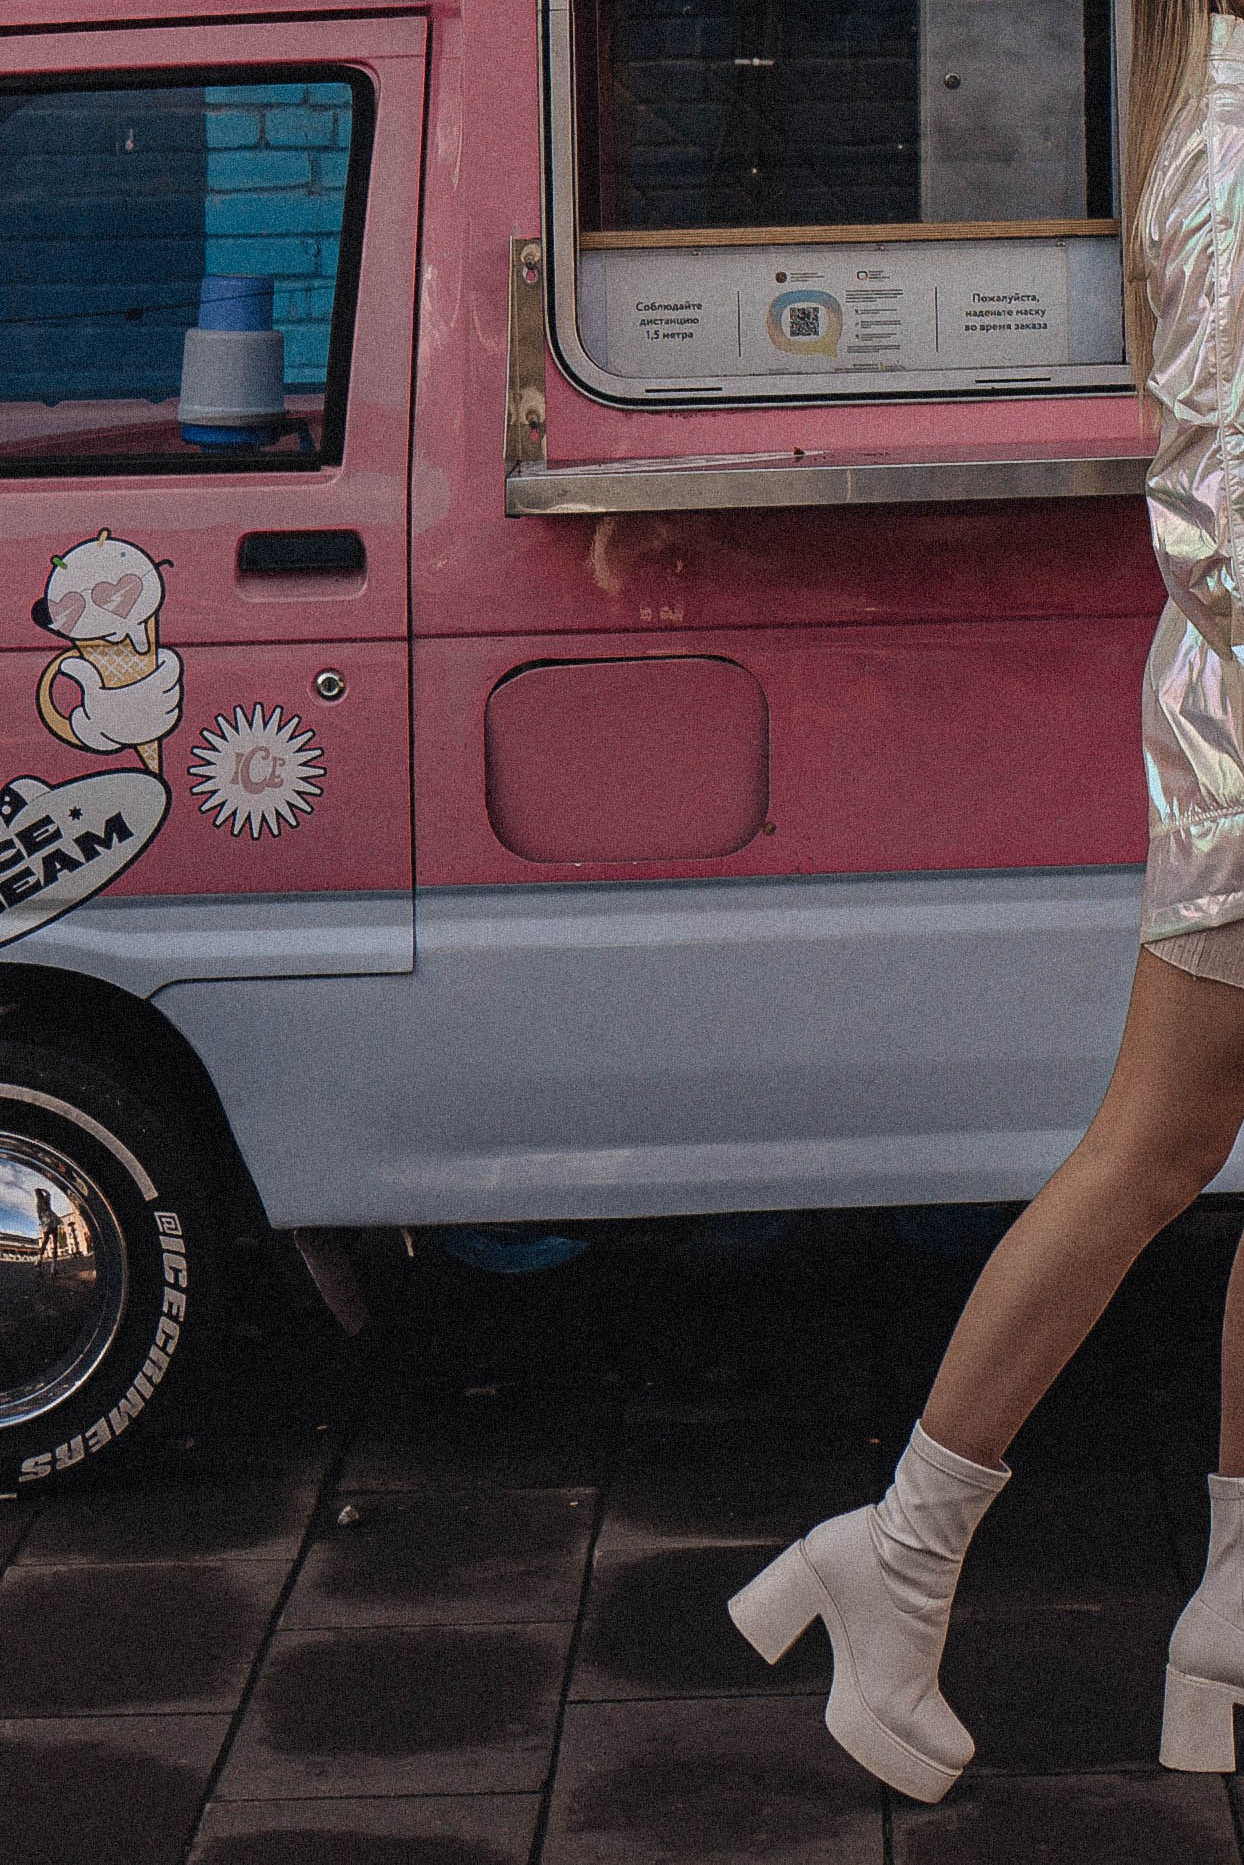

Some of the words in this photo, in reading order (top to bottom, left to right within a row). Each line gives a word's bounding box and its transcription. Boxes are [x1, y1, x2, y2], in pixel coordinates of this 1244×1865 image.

[972, 292, 1040, 305] Пожалуйста,
[635, 301, 703, 312] Соблюдайте
[965, 309, 1014, 318] наденьте
[1015, 308, 1047, 318] маску
[639, 317, 700, 327] дистанцию
[964, 324, 978, 332] во
[979, 323, 1012, 333] время
[1014, 321, 1048, 331] заказа
[645, 329, 660, 341] 1,5
[662, 331, 694, 341] метра
[229, 745, 286, 795] ICE
[0, 814, 64, 875] CE
[0, 811, 135, 913] EAM
[18, 1211, 189, 1483] @ICECRIMERS
